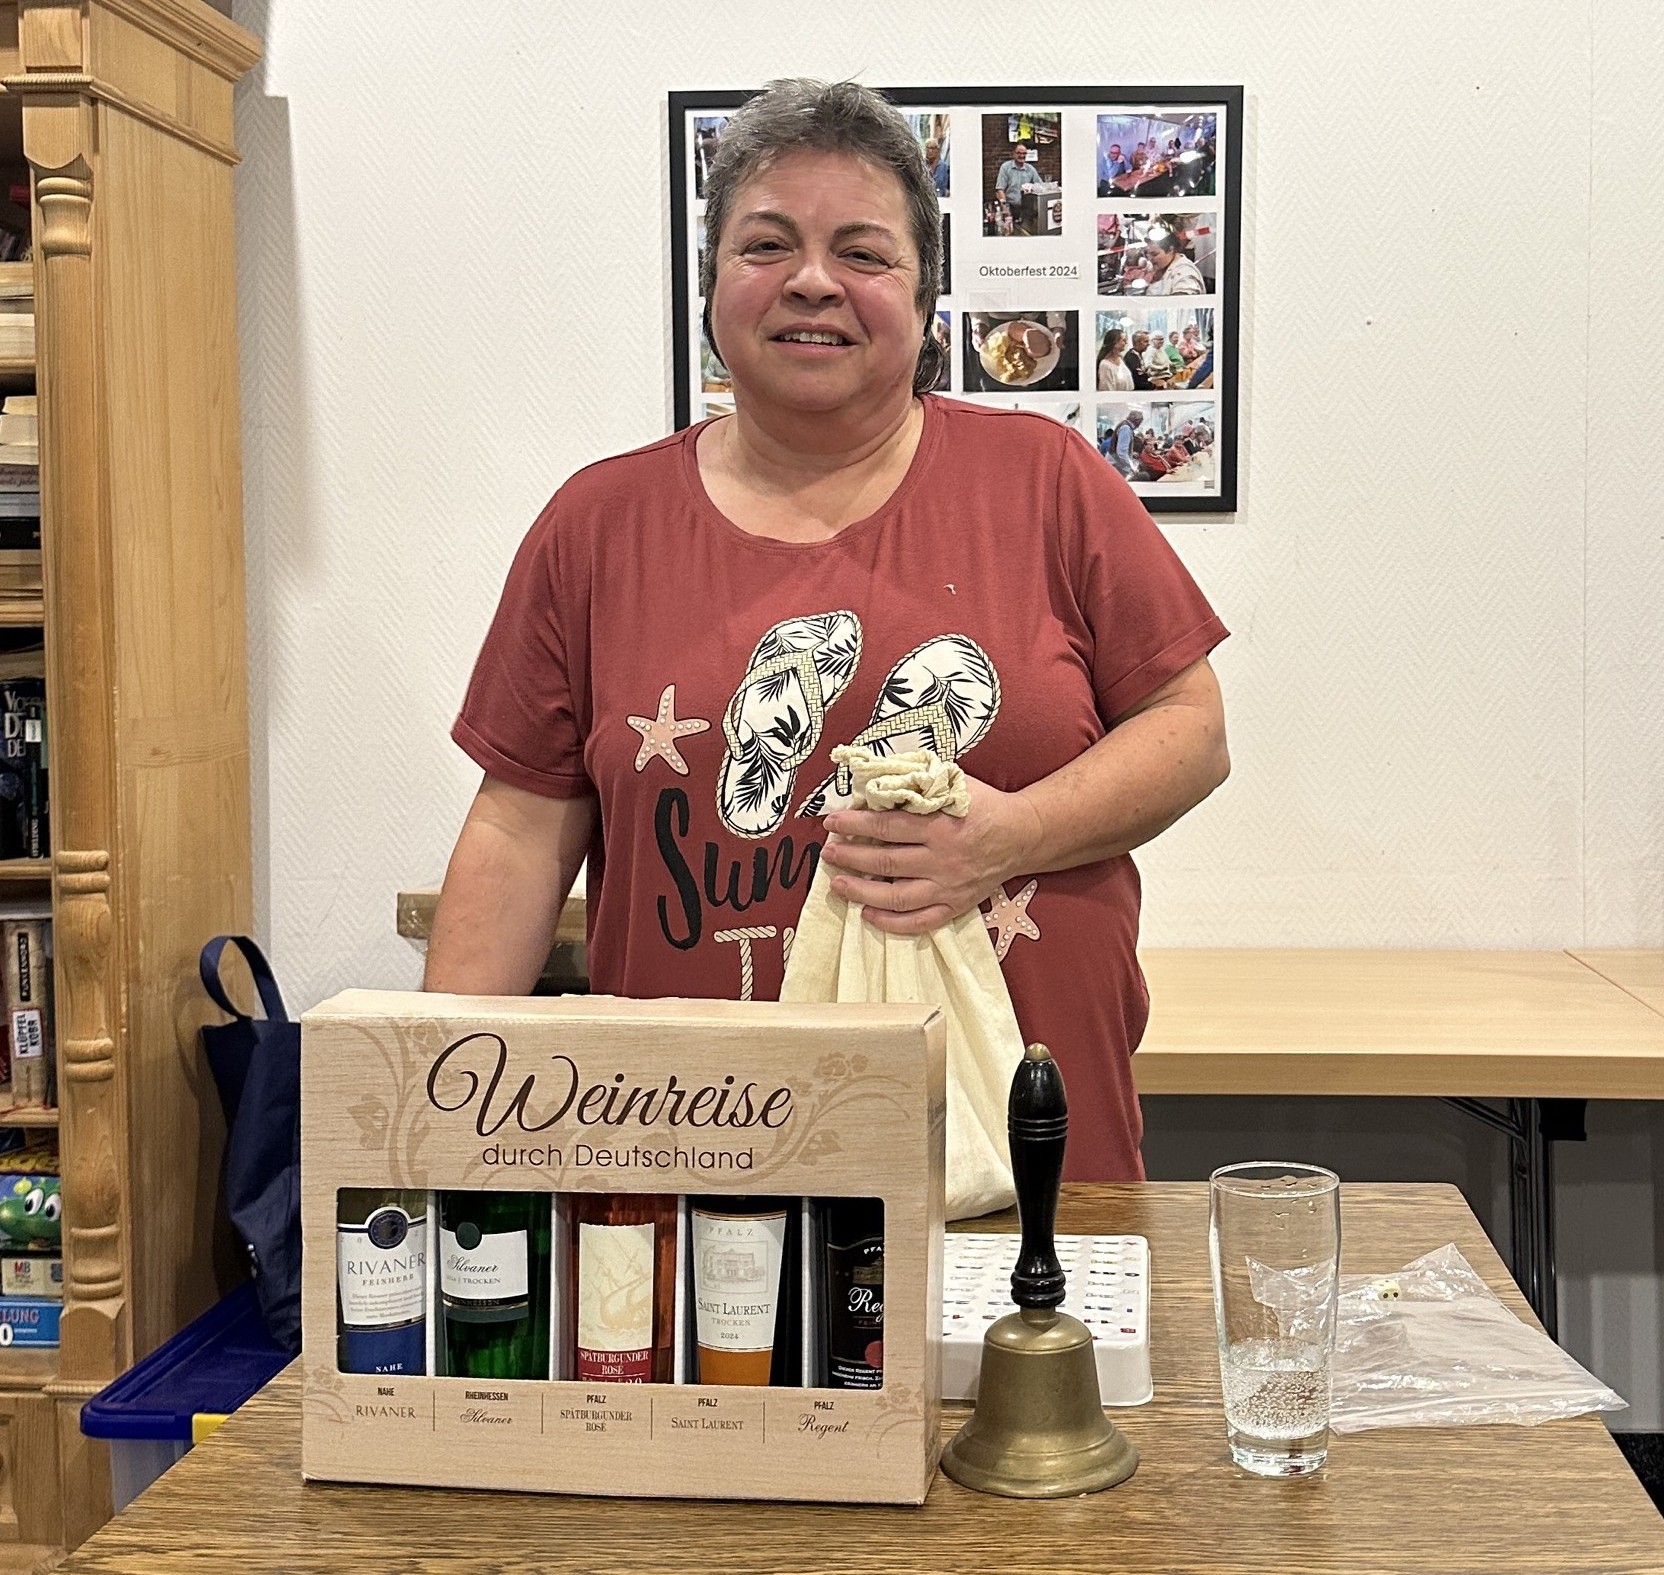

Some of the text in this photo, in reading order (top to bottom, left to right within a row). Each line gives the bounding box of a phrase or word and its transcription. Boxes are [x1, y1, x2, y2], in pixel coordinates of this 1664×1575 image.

[979, 265, 1078, 277] Oktoberfest 2024
[654, 787, 823, 951] Sum
[427, 1032, 794, 1137] Weinreise
[482, 1143, 754, 1169] durch Deutschland
[709, 1226, 754, 1236] PFALZ
[863, 1245, 884, 1255] PFA
[14, 1260, 30, 1273] MB
[347, 1252, 427, 1276] RIVANER
[446, 1254, 500, 1273] Silvaner
[362, 1273, 415, 1287] FEINHERB
[463, 1277, 501, 1285] TROCKEN
[698, 1297, 771, 1316] SAINT LAURENT
[847, 1286, 885, 1323] Reg
[711, 1317, 751, 1327] TROCKEN
[720, 1331, 739, 1340] 2024
[375, 1363, 403, 1373] NAHE
[377, 1387, 395, 1397] NAHE
[464, 1390, 509, 1401] RHEINHESSEN
[586, 1394, 607, 1404] PFALZ
[697, 1397, 718, 1407] PFALZ
[813, 1400, 835, 1410] PFALZ
[355, 1404, 417, 1419] RIVANER
[460, 1407, 513, 1425] Silvaner
[671, 1416, 744, 1430] SAINT LAURENT
[797, 1413, 849, 1440] Regent
